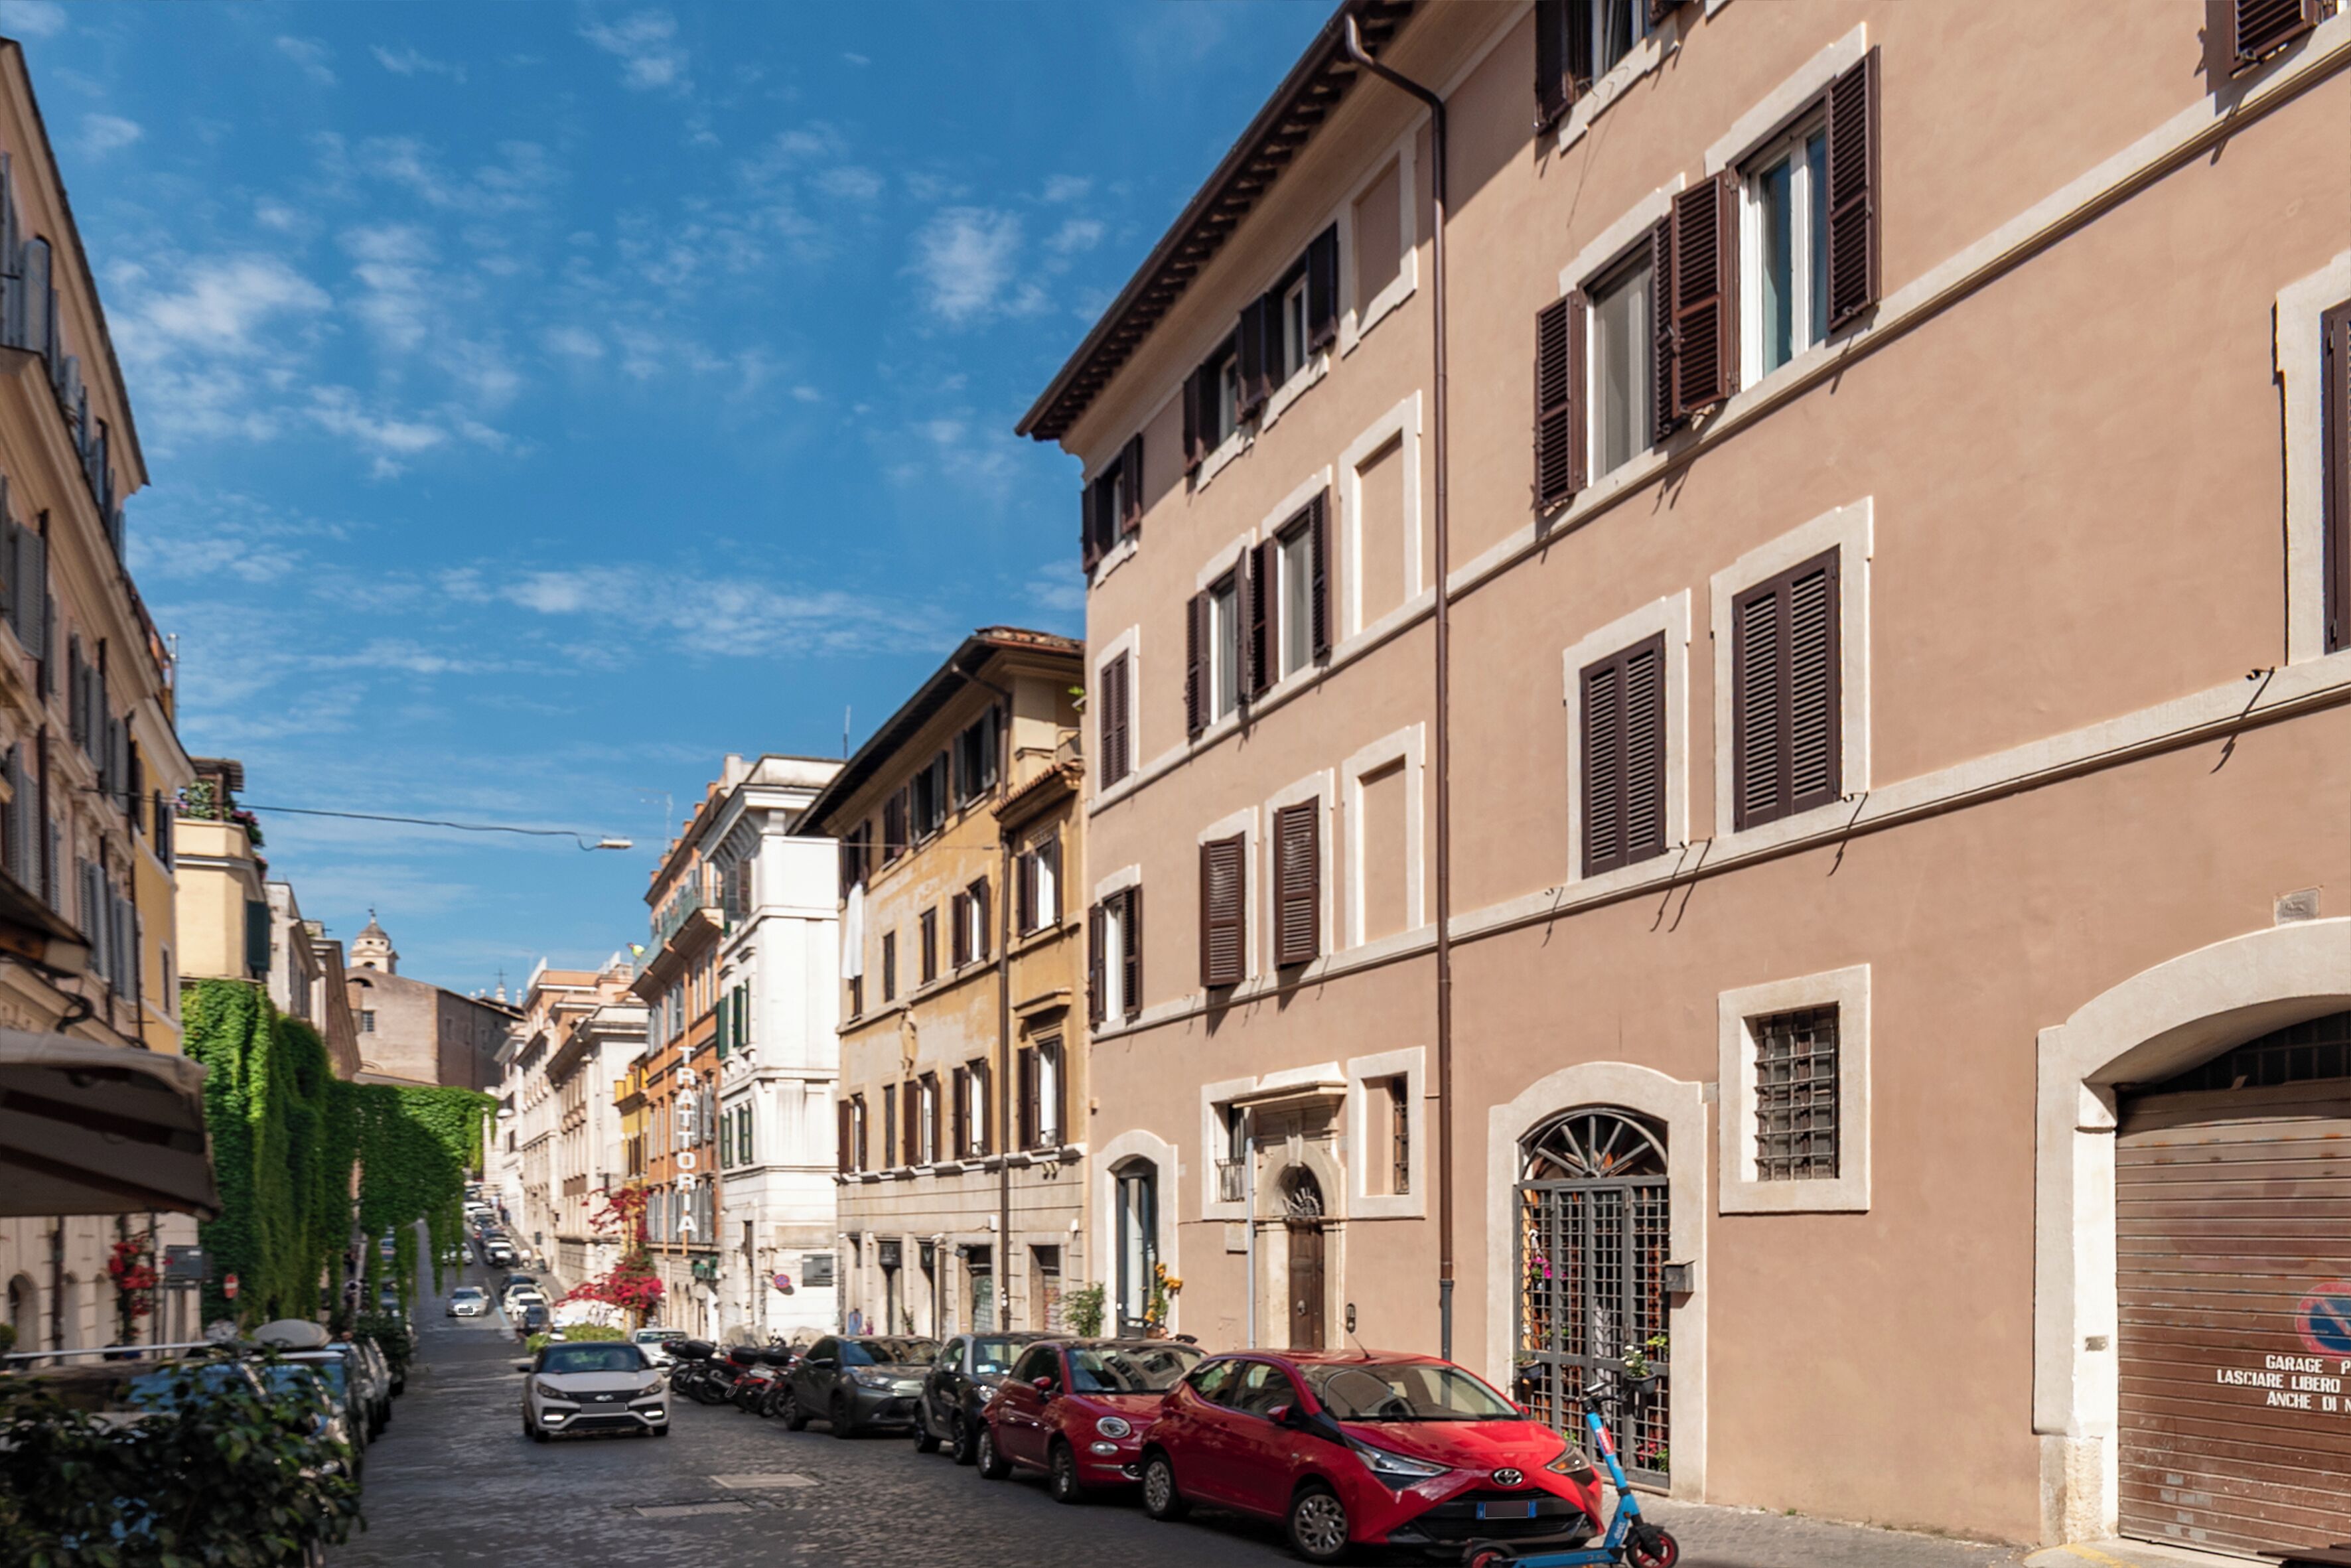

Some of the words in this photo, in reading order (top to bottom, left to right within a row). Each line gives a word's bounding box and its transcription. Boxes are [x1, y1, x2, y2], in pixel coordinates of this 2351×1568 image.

[676, 1046, 697, 1233] TRATTORIA
[2265, 1354, 2323, 1374] GARAGE
[2217, 1369, 2284, 1389] LASCIARE
[2291, 1375, 2341, 1393] LIBERO
[2266, 1390, 2312, 1409] ANCHE
[2322, 1395, 2337, 1412] DI
